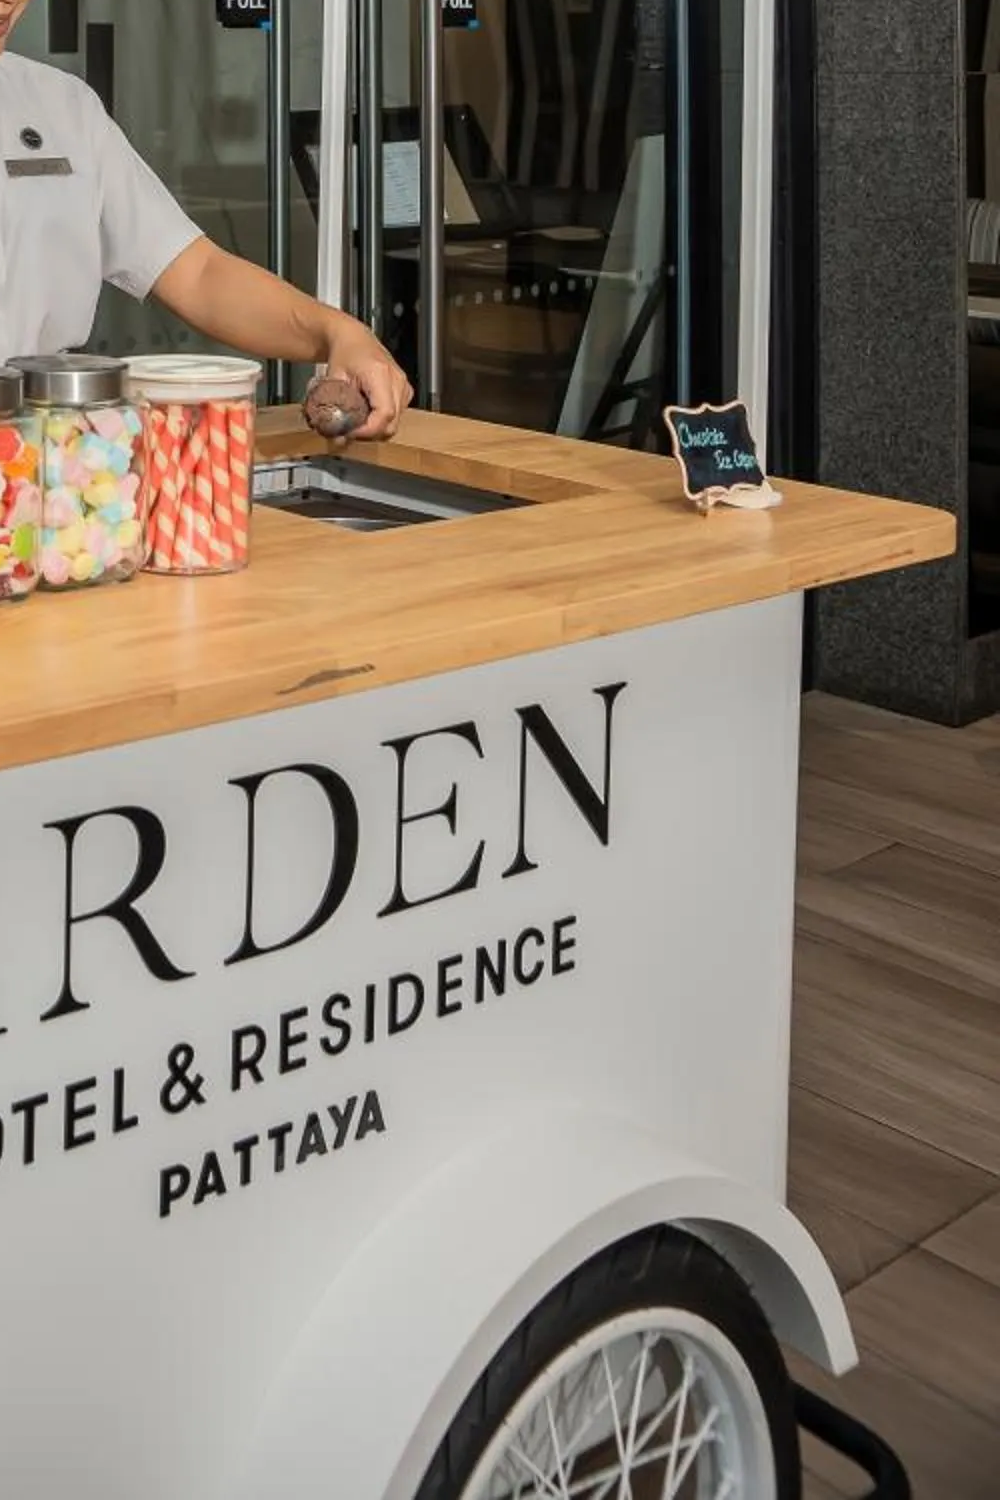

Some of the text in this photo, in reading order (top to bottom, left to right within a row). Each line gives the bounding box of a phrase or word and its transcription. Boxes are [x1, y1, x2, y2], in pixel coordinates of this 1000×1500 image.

[159, 1043, 206, 1115] &
[231, 915, 577, 1092] RESIDENCE
[159, 1090, 386, 1218] PATTAYA
